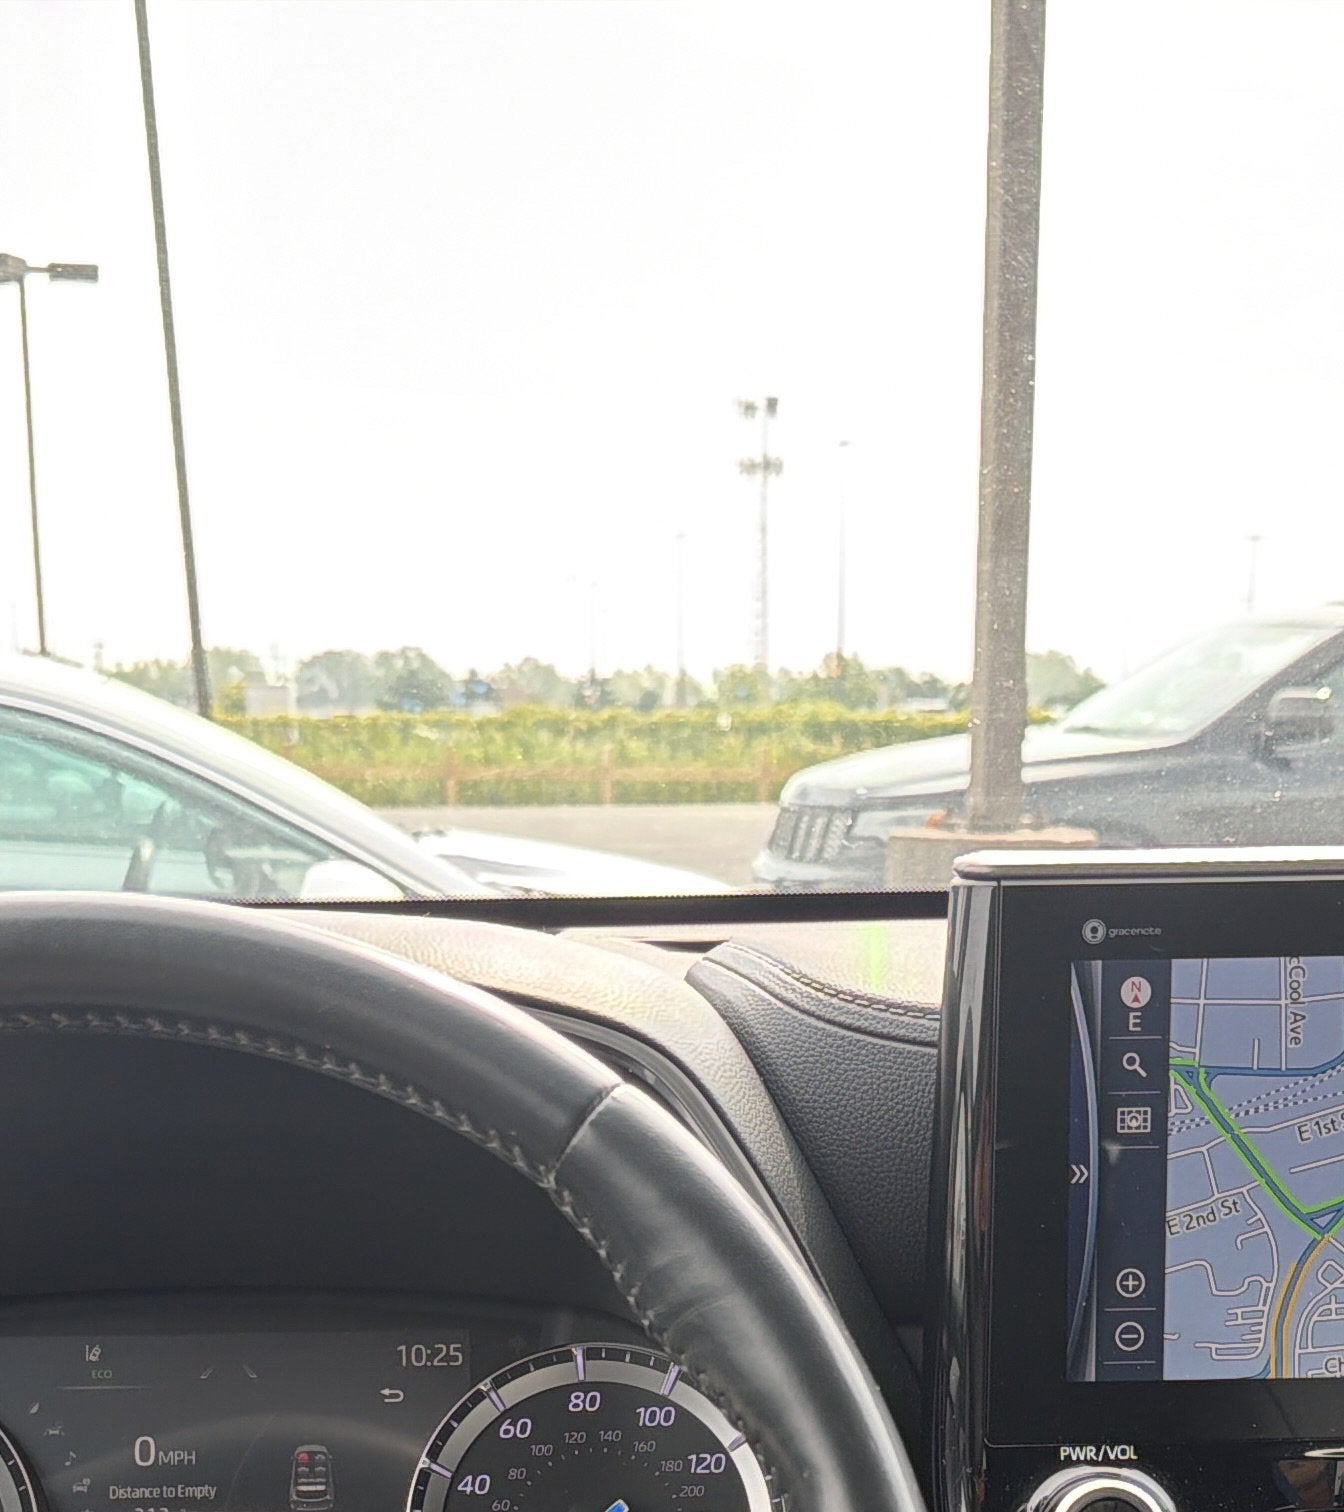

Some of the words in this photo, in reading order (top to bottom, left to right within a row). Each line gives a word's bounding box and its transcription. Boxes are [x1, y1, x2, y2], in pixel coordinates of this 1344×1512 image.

[1108, 926, 1162, 938] gracenote
[1128, 1011, 1143, 1032] E
[1289, 1010, 1307, 1046] Ave
[1297, 1124, 1311, 1142] E
[1313, 1118, 1338, 1138] 1st
[1166, 1218, 1179, 1236] E
[1183, 1206, 1217, 1231] 2nd
[1219, 1199, 1241, 1219] St
[396, 1344, 463, 1368] 10:25
[91, 1369, 113, 1380] ECO
[568, 1391, 601, 1412] 80
[635, 1406, 676, 1427] 100
[499, 1418, 532, 1439] 60
[598, 1430, 622, 1443] 140
[563, 1431, 587, 1445] 120
[633, 1440, 656, 1453] 160
[134, 1436, 156, 1468] 0
[158, 1450, 196, 1466] MPH
[530, 1444, 553, 1457] 100
[1059, 1445, 1138, 1462] PWR/VOL
[660, 1460, 683, 1473] 180
[687, 1453, 726, 1474] 120
[508, 1468, 527, 1481] 80
[109, 1484, 159, 1500] Distance
[162, 1485, 176, 1498] to
[177, 1484, 217, 1502] Empty
[457, 1474, 491, 1495] 40
[680, 1485, 705, 1498] 200
[492, 1499, 510, 1512] 60
